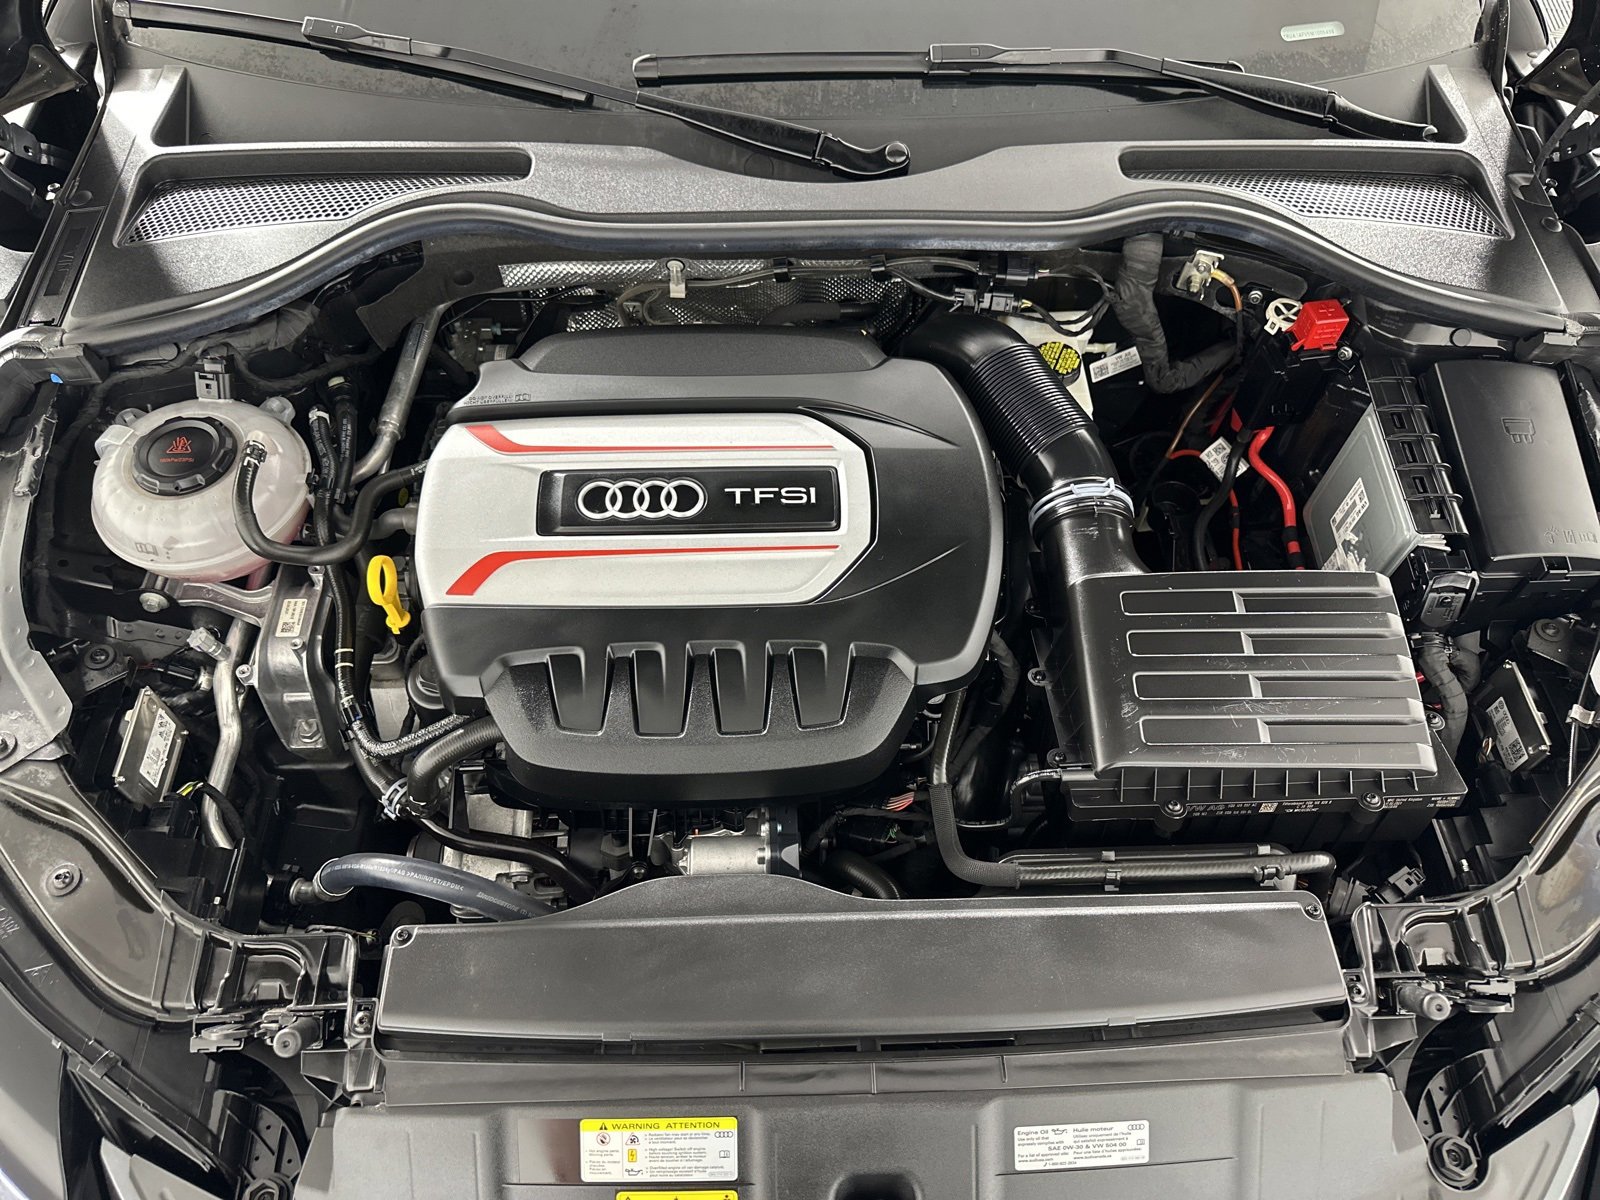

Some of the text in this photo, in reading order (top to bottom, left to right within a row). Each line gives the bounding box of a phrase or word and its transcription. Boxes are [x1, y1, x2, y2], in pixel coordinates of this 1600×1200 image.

[724, 486, 818, 506] TFSI
[611, 1121, 720, 1130] WARNING ATTENTION
